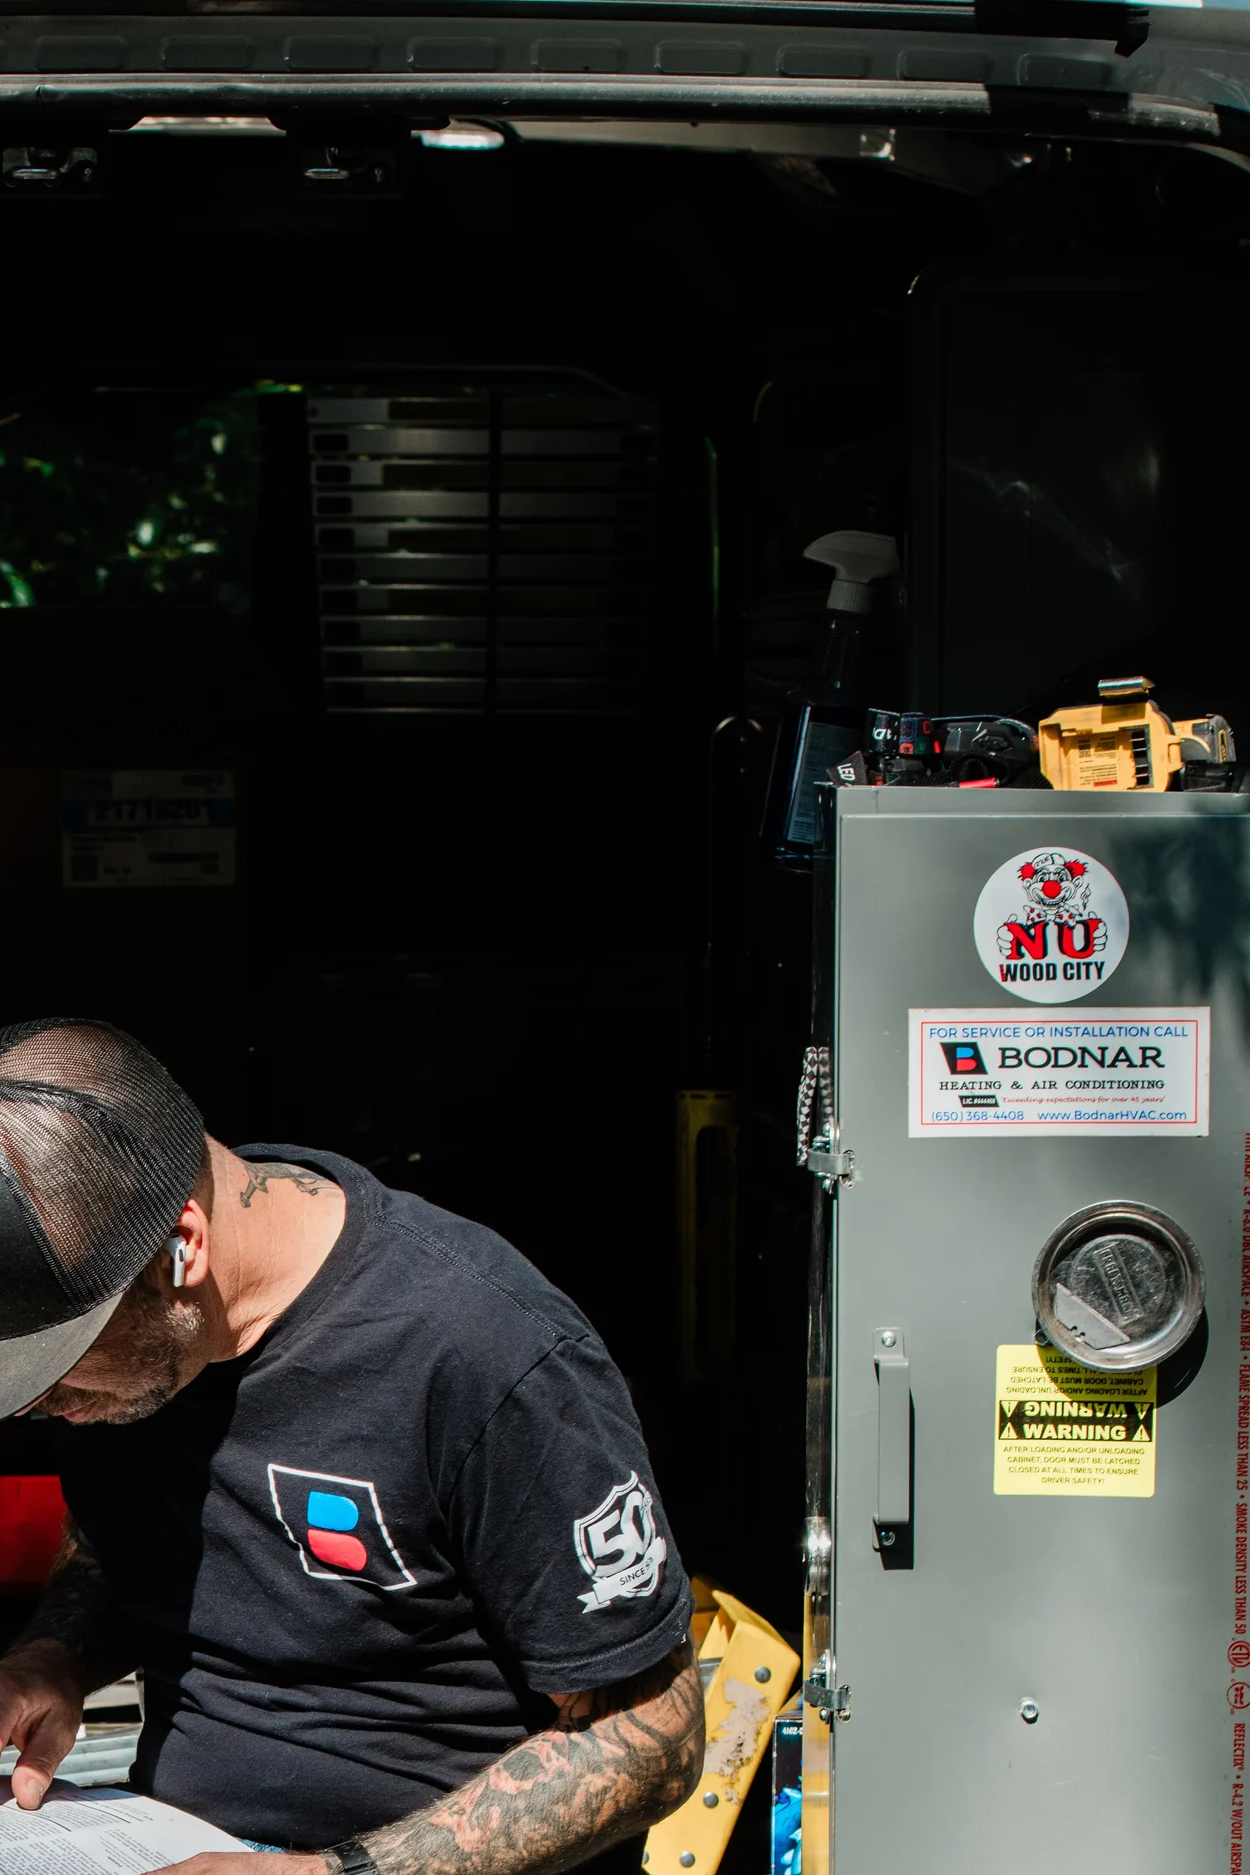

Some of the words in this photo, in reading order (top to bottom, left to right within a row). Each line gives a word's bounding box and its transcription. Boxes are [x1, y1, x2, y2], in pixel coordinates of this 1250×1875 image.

[837, 763, 856, 781] LED
[1004, 918, 1102, 960] NU
[999, 963, 1057, 982] WOOD
[1063, 961, 1105, 980] CITY
[930, 1028, 957, 1038] FOR
[962, 1027, 1020, 1038] SERVICE
[1025, 1027, 1045, 1037] OR
[1050, 1026, 1149, 1037] INSTALLATION
[1154, 1026, 1189, 1037] CALL
[998, 1046, 1165, 1068] BODNAR
[939, 1081, 1002, 1090] HEATING
[1010, 1081, 1023, 1090] &
[1031, 1081, 1058, 1089] AIR
[1065, 1080, 1165, 1090] CONDITIONING
[1097, 1096, 1110, 1104] for
[932, 1111, 963, 1122] (650)
[966, 1111, 1024, 1121] 368-4408
[1037, 1110, 1187, 1121] www.BodnarHVAC.com
[1241, 1255, 1250, 1296] AIRSPACE
[1240, 1309, 1250, 1334] ASTM
[1240, 1336, 1250, 1351] E84
[1239, 1364, 1250, 1391] FLAME
[1024, 1402, 1127, 1417] WARNING
[1238, 1395, 1249, 1428] SPREAD
[1023, 1424, 1127, 1440] WARNING
[1238, 1432, 1248, 1450] LESS
[1237, 1453, 1248, 1477] THAN
[1236, 1480, 1248, 1490] 25
[1236, 1503, 1248, 1534] SMOKE
[1236, 1537, 1248, 1573] DENSITY
[620, 1567, 645, 1586] SINCE
[1236, 1576, 1247, 1594] LESS
[1235, 1597, 1246, 1620] THAN
[1235, 1624, 1246, 1634] 50
[1231, 1783, 1244, 1806] R-4.2
[1231, 1809, 1243, 1840] W/OUT
